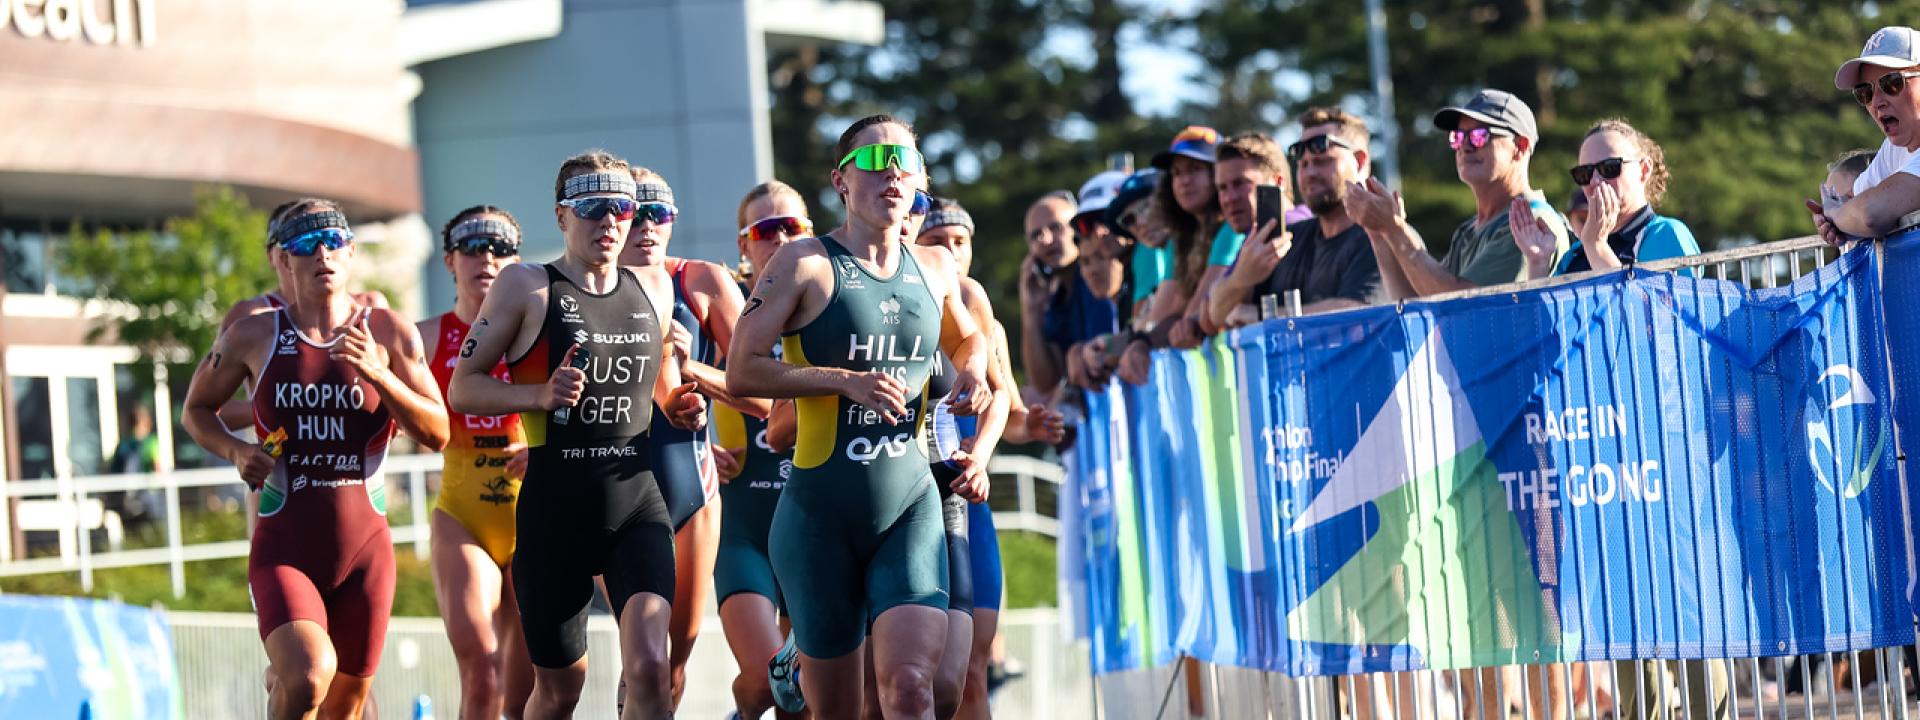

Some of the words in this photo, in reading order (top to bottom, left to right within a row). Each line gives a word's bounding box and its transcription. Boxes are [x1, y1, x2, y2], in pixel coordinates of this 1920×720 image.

[881, 315, 900, 324] AIS
[592, 333, 650, 344] SUZUKI
[848, 333, 925, 361] HILL
[275, 377, 364, 409] KROPKÓ
[580, 396, 632, 423] GER
[847, 404, 916, 425] fieza
[297, 415, 345, 440] HUN
[1524, 407, 1591, 444] RACE
[1597, 402, 1627, 437] IN
[289, 454, 358, 466] FACTOR
[562, 449, 584, 459] TRI
[589, 445, 638, 458] TRAVEL
[1497, 468, 1561, 512] THE
[1566, 459, 1661, 507] GONG
